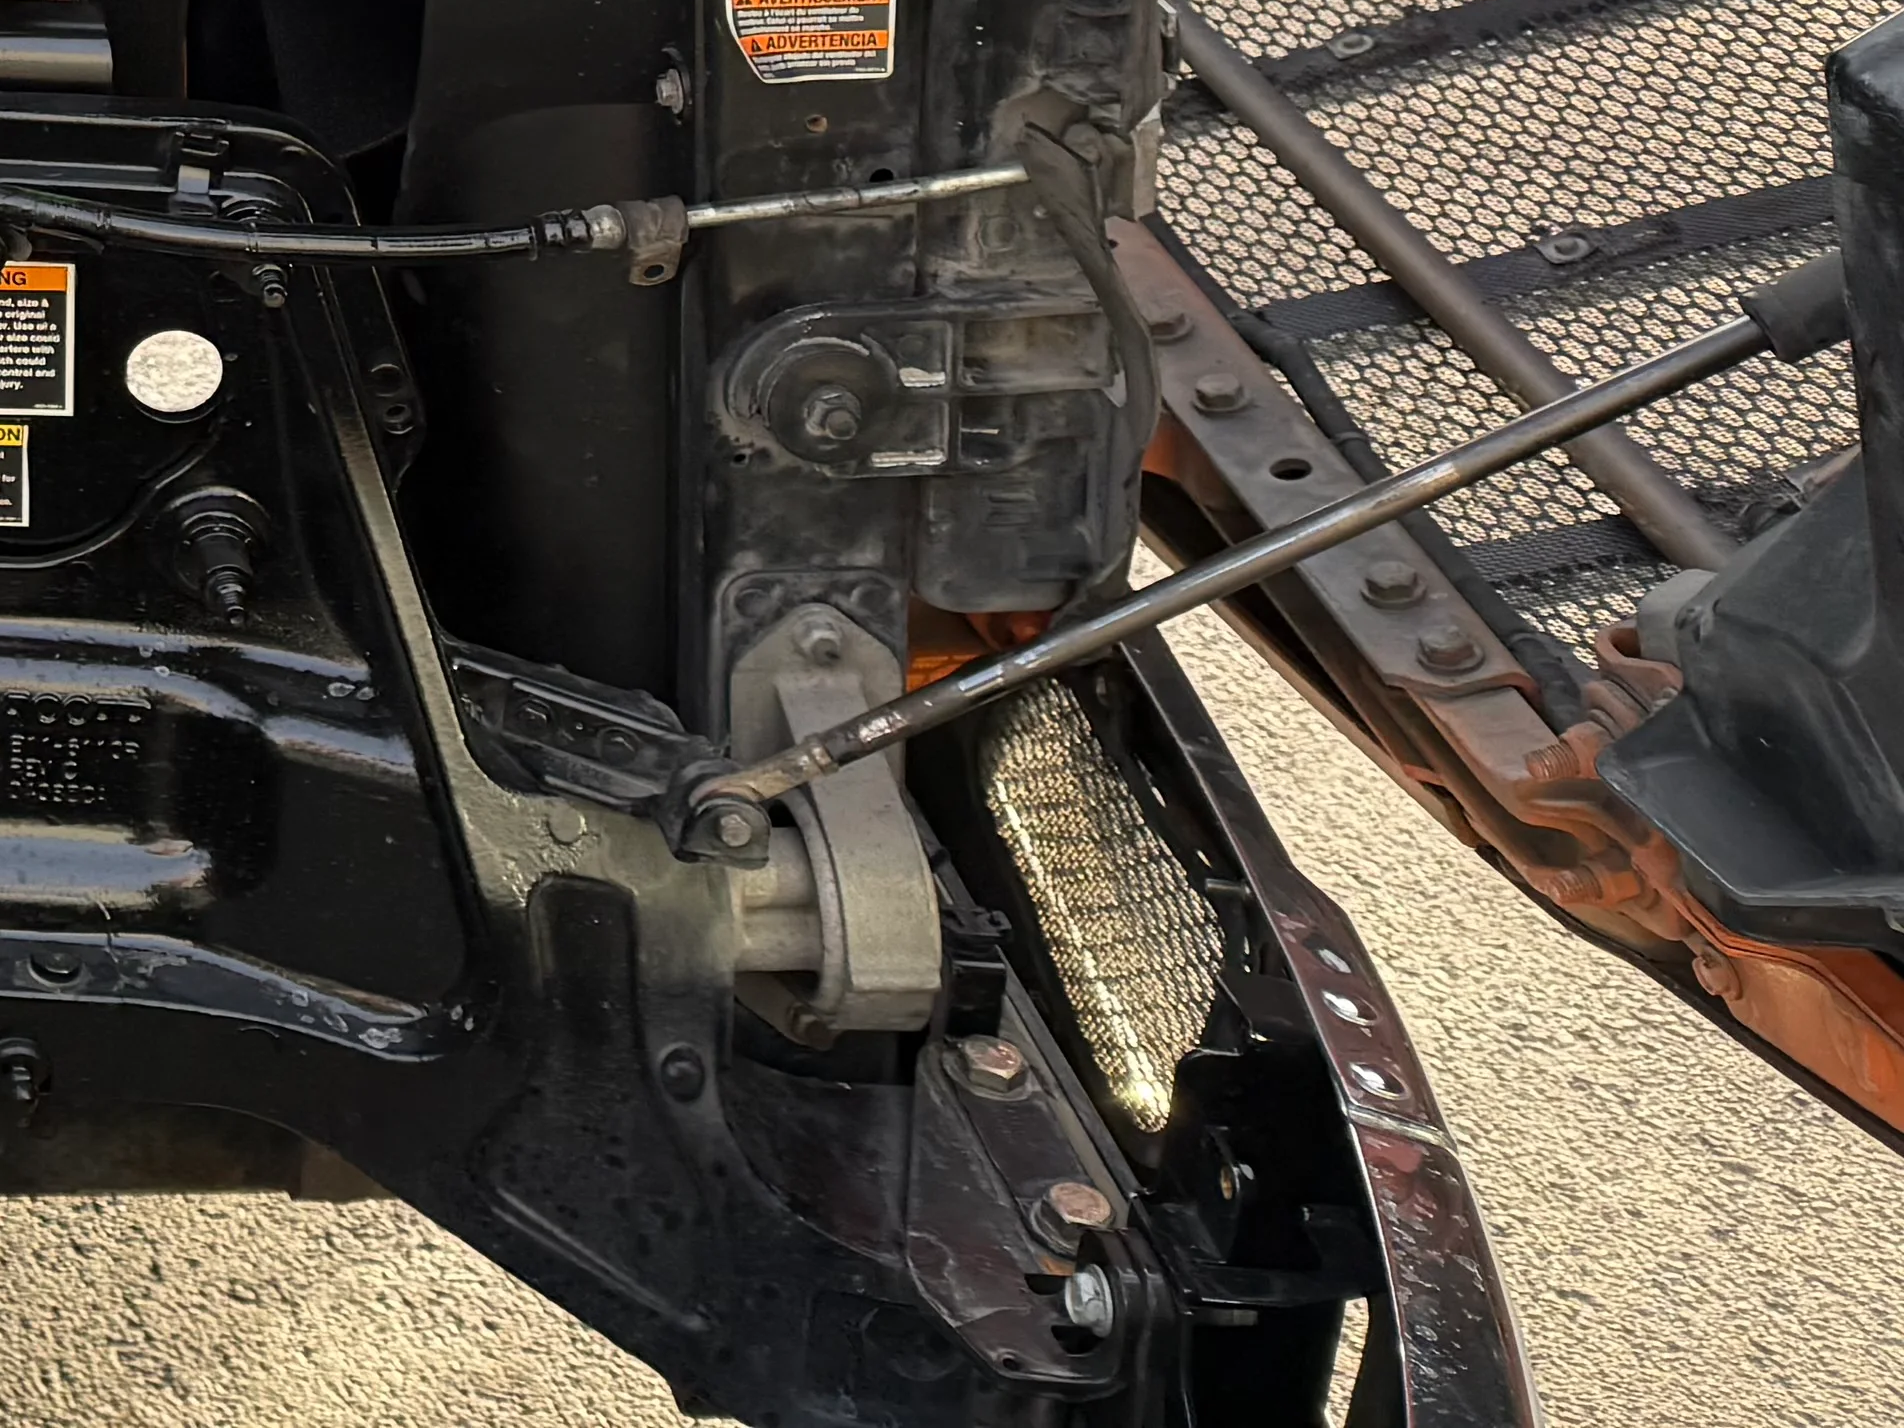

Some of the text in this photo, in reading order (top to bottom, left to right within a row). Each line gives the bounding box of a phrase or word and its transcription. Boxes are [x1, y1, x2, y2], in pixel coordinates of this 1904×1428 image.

[766, 33, 877, 49] ADVERTENCIA
[17, 298, 38, 307] size
[4, 310, 45, 320] original
[13, 322, 34, 331] Use
[36, 322, 48, 330] of
[6, 333, 28, 342] size
[30, 334, 60, 343] could
[32, 345, 54, 354] with
[16, 357, 46, 366] could
[35, 369, 55, 377] and
